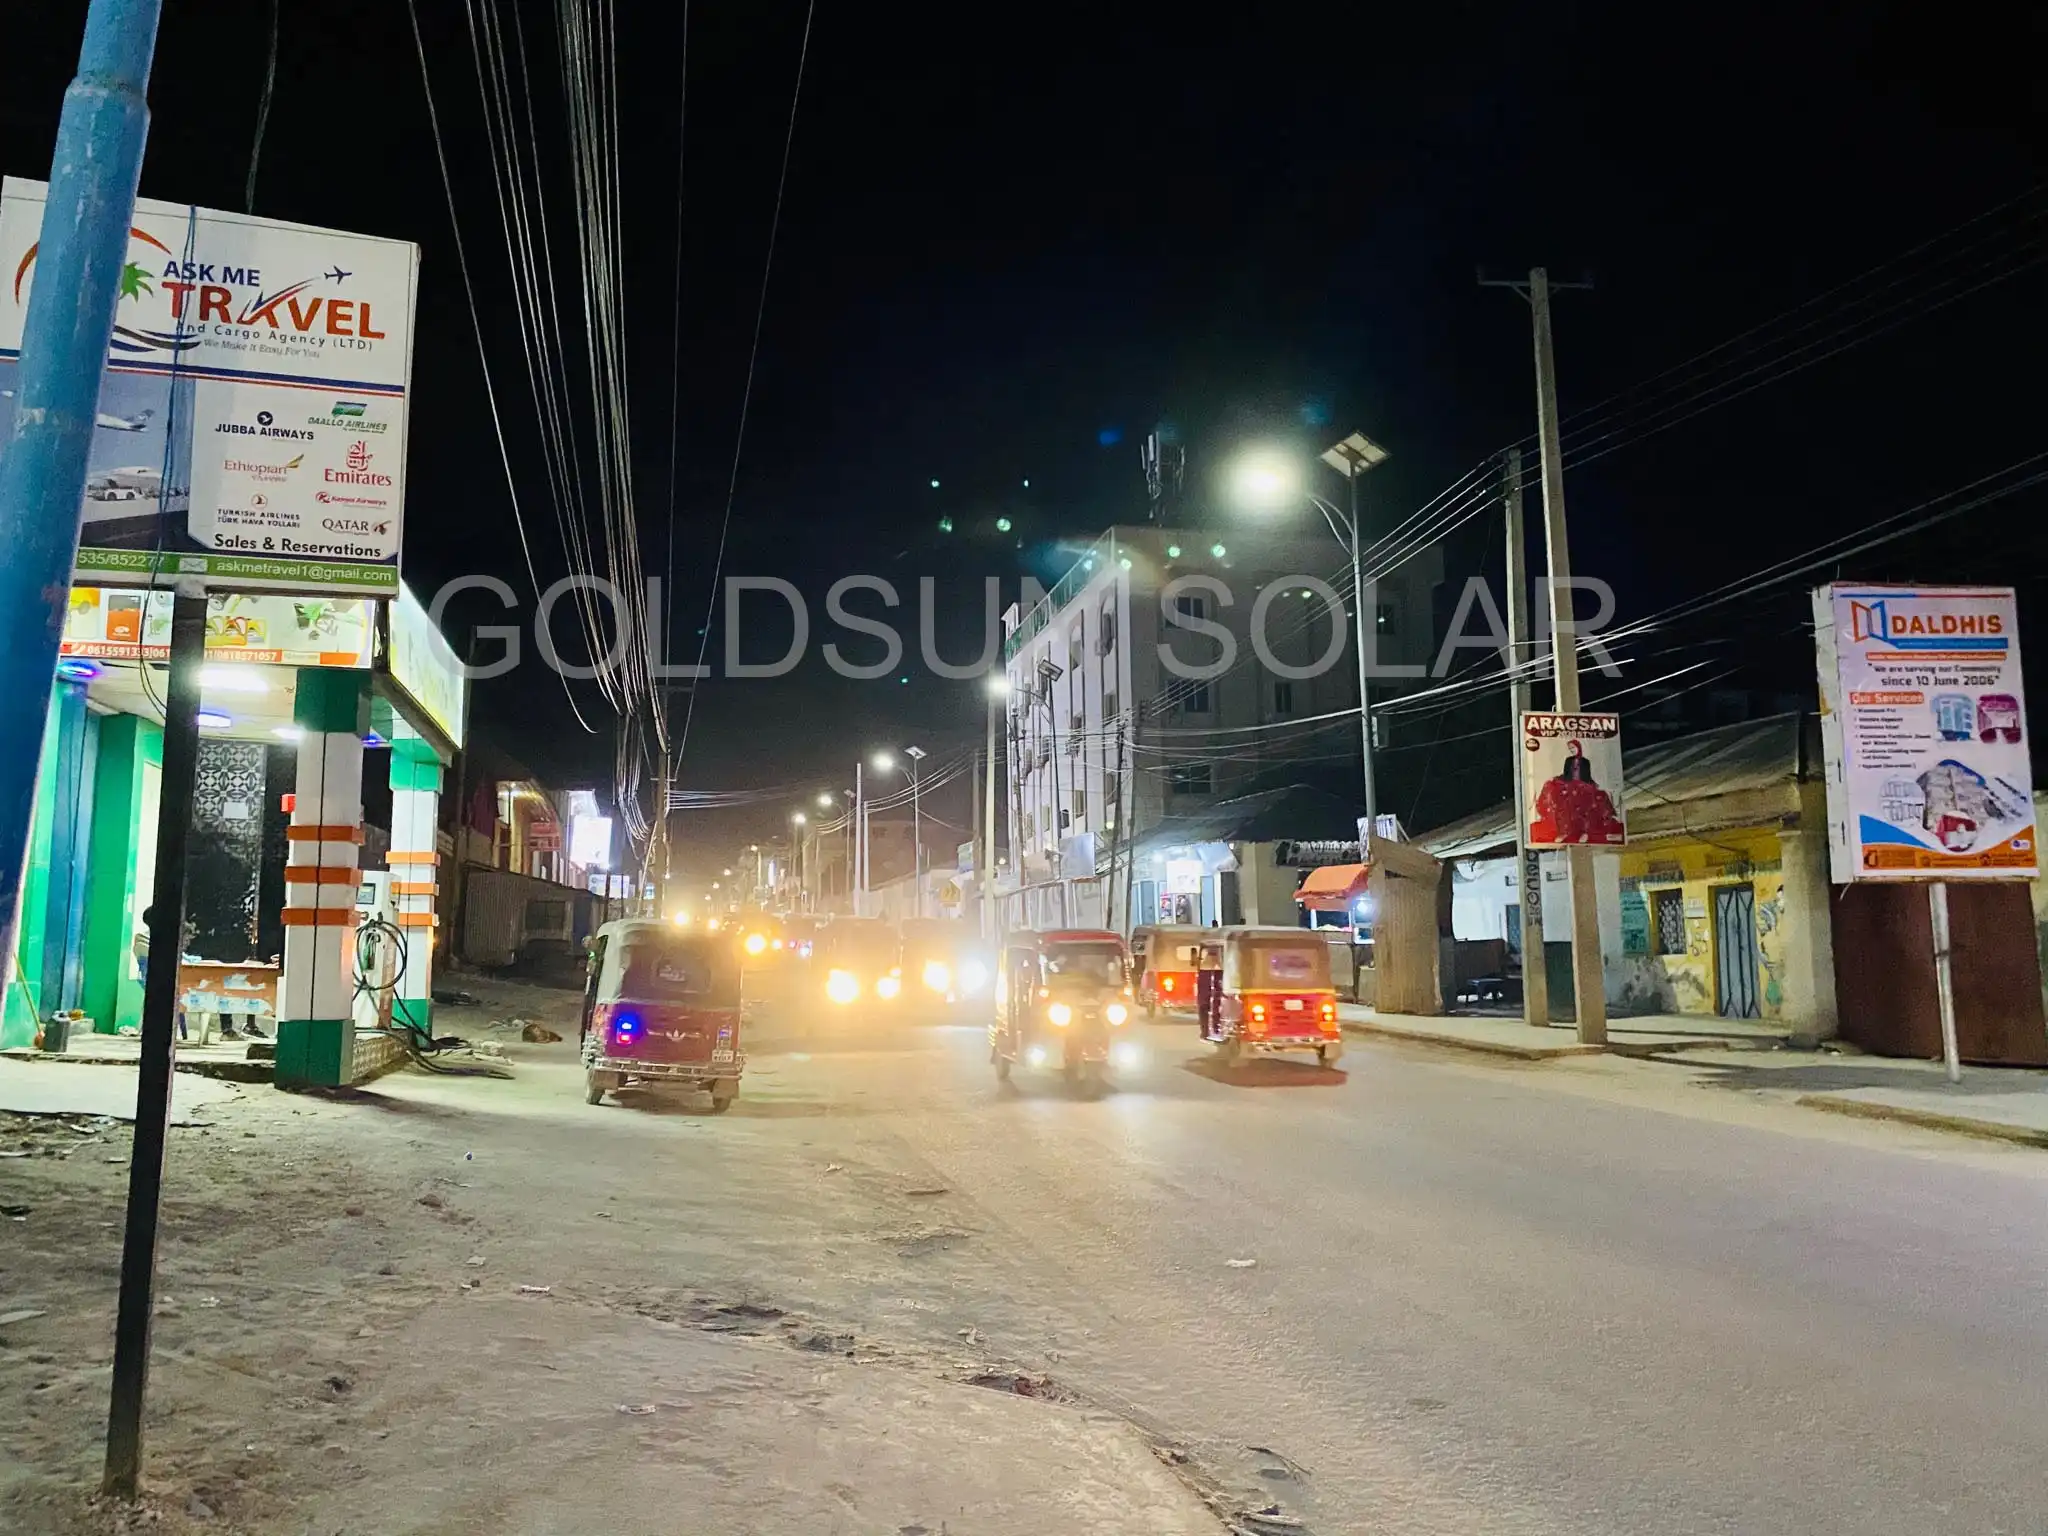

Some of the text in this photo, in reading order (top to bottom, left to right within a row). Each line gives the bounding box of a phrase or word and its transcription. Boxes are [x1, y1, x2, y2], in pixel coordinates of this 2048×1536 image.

[163, 260, 261, 287] ASK ME
[161, 281, 385, 340] TRAVEL
[214, 325, 260, 339] Cargo
[268, 330, 325, 347] Agency
[333, 338, 373, 351] (LTD)
[215, 423, 256, 435] JUBBA
[260, 427, 314, 441] AIRWAYS
[308, 416, 344, 427] DAALLO
[345, 420, 387, 431] AIRLINES
[224, 460, 287, 475] Ethiopian
[324, 468, 392, 486] Emirates
[260, 511, 300, 520] AIRLINES
[322, 518, 369, 532] QATAR
[214, 533, 381, 557] Sales & Reservations
[216, 560, 392, 582] askmetravel1@gmail.com
[1891, 615, 2003, 634] DALDHIS
[1881, 676, 1912, 686] since
[1934, 676, 1959, 686] June
[1527, 716, 1616, 731] ARAGSAN
